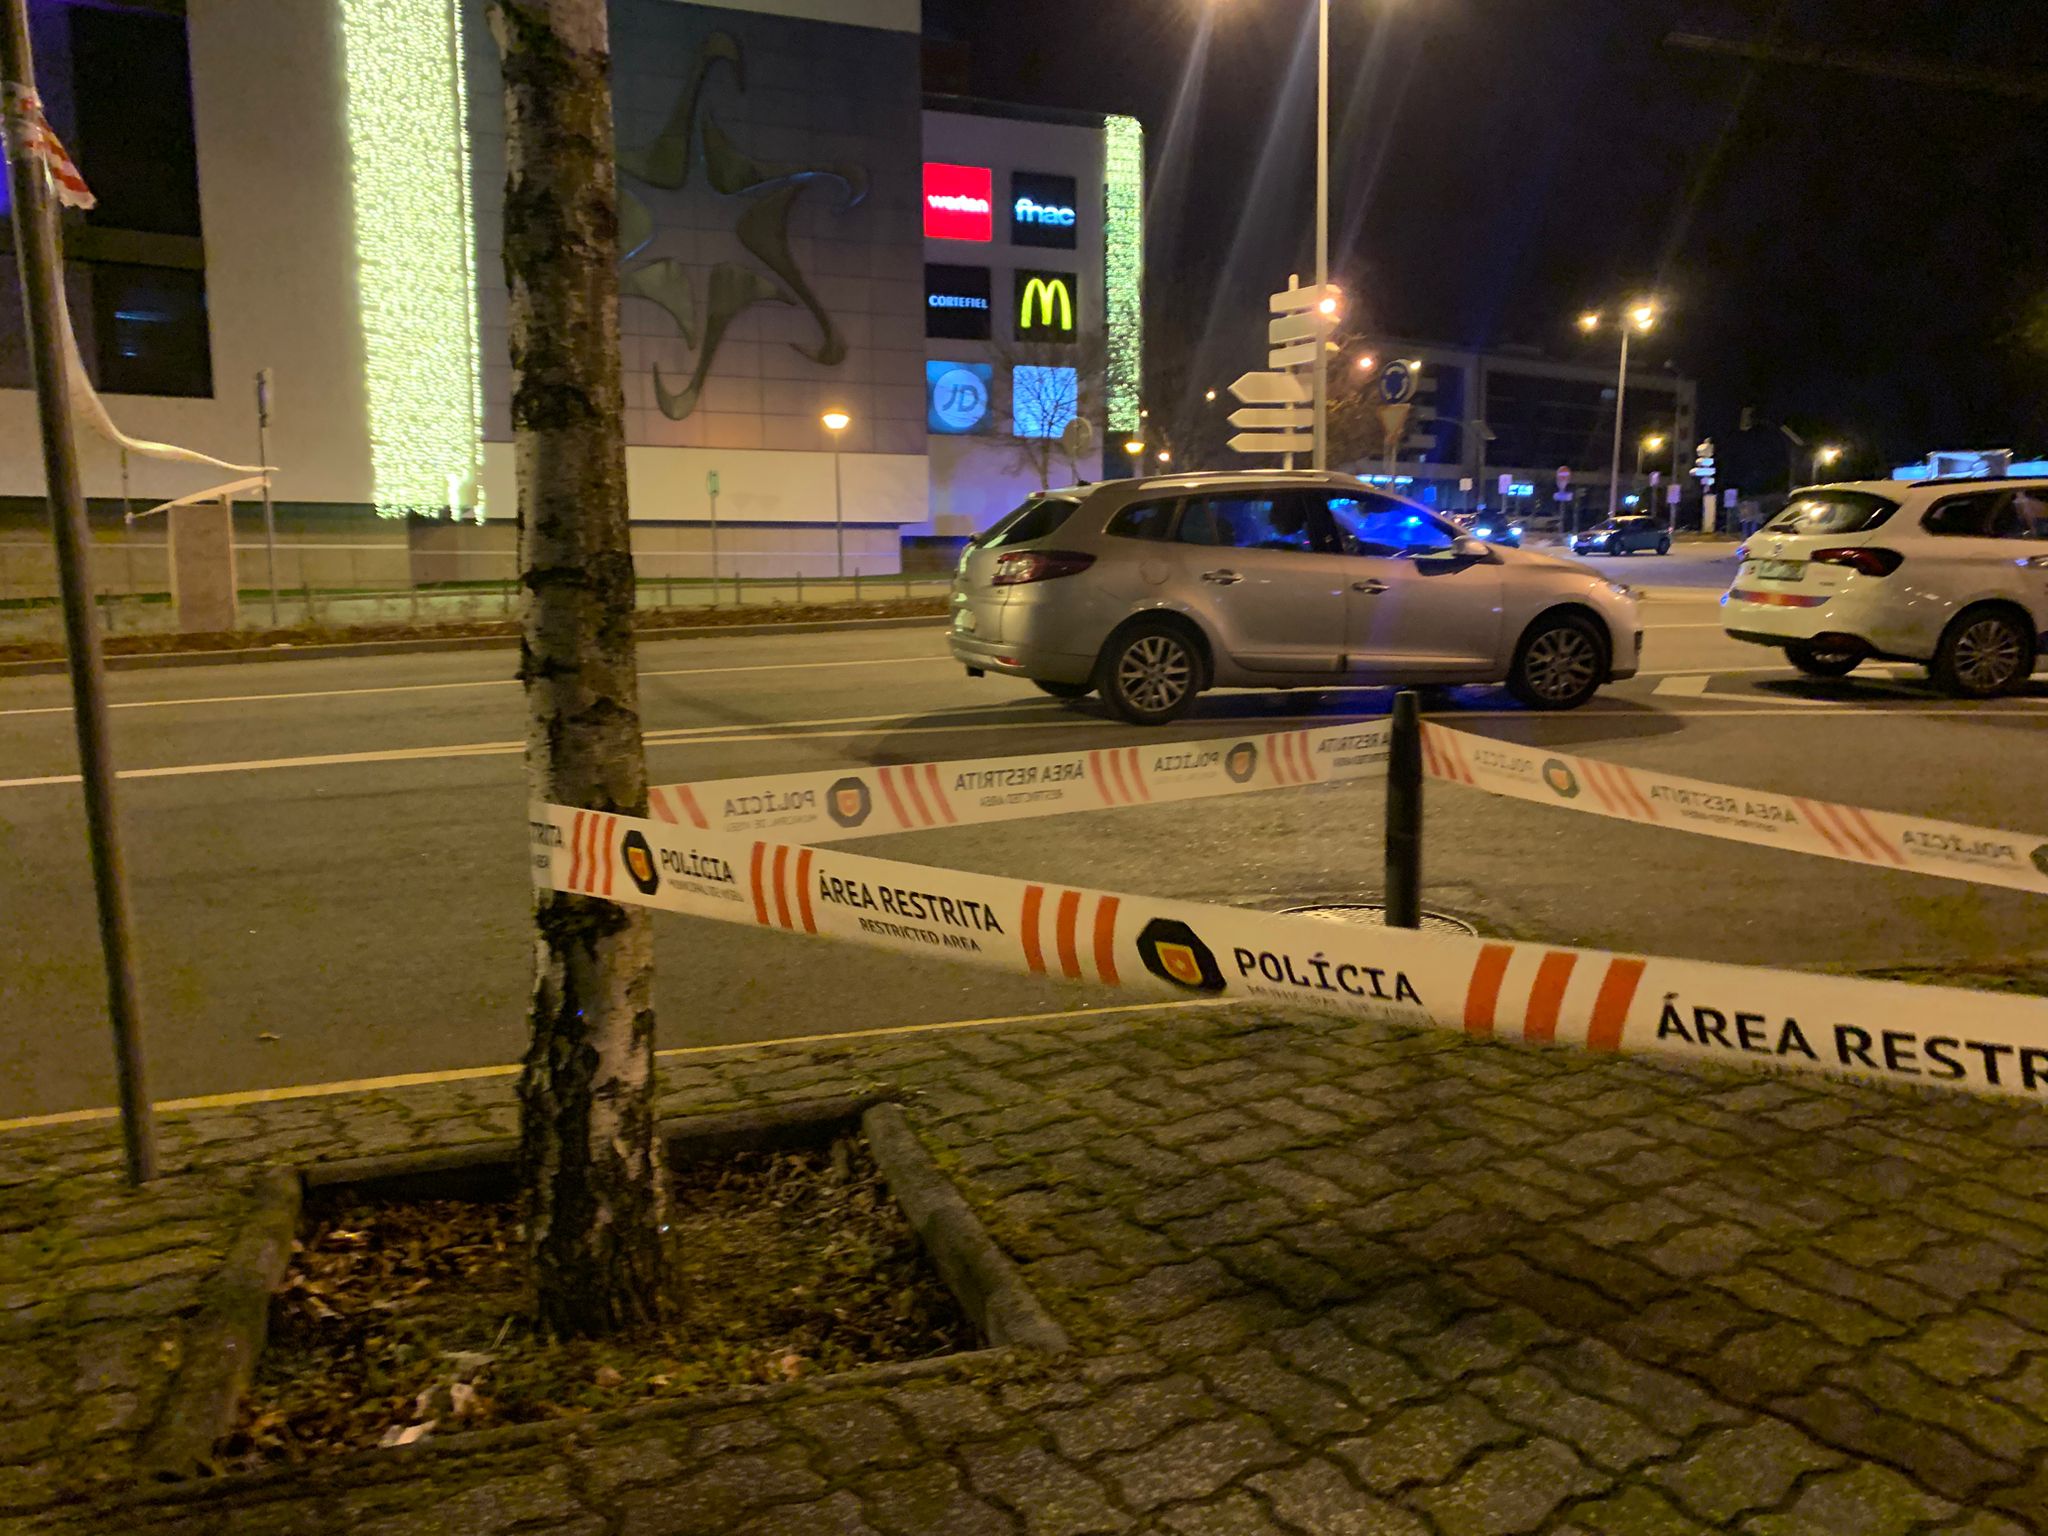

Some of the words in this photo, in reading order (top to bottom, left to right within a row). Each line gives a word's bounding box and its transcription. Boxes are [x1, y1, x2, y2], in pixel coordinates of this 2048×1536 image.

[1015, 198, 1076, 226] fnac
[928, 294, 988, 309] CORTEFIEL
[942, 383, 979, 412] JD
[660, 848, 737, 884] POLÍCIA
[819, 869, 880, 911] ÁREA
[879, 885, 1005, 935] RESTRITA
[860, 917, 940, 946] RESTRICTED
[943, 935, 983, 951] AREA
[1233, 947, 1423, 1006] POLÍCIA
[1657, 991, 1820, 1062] ÁREA
